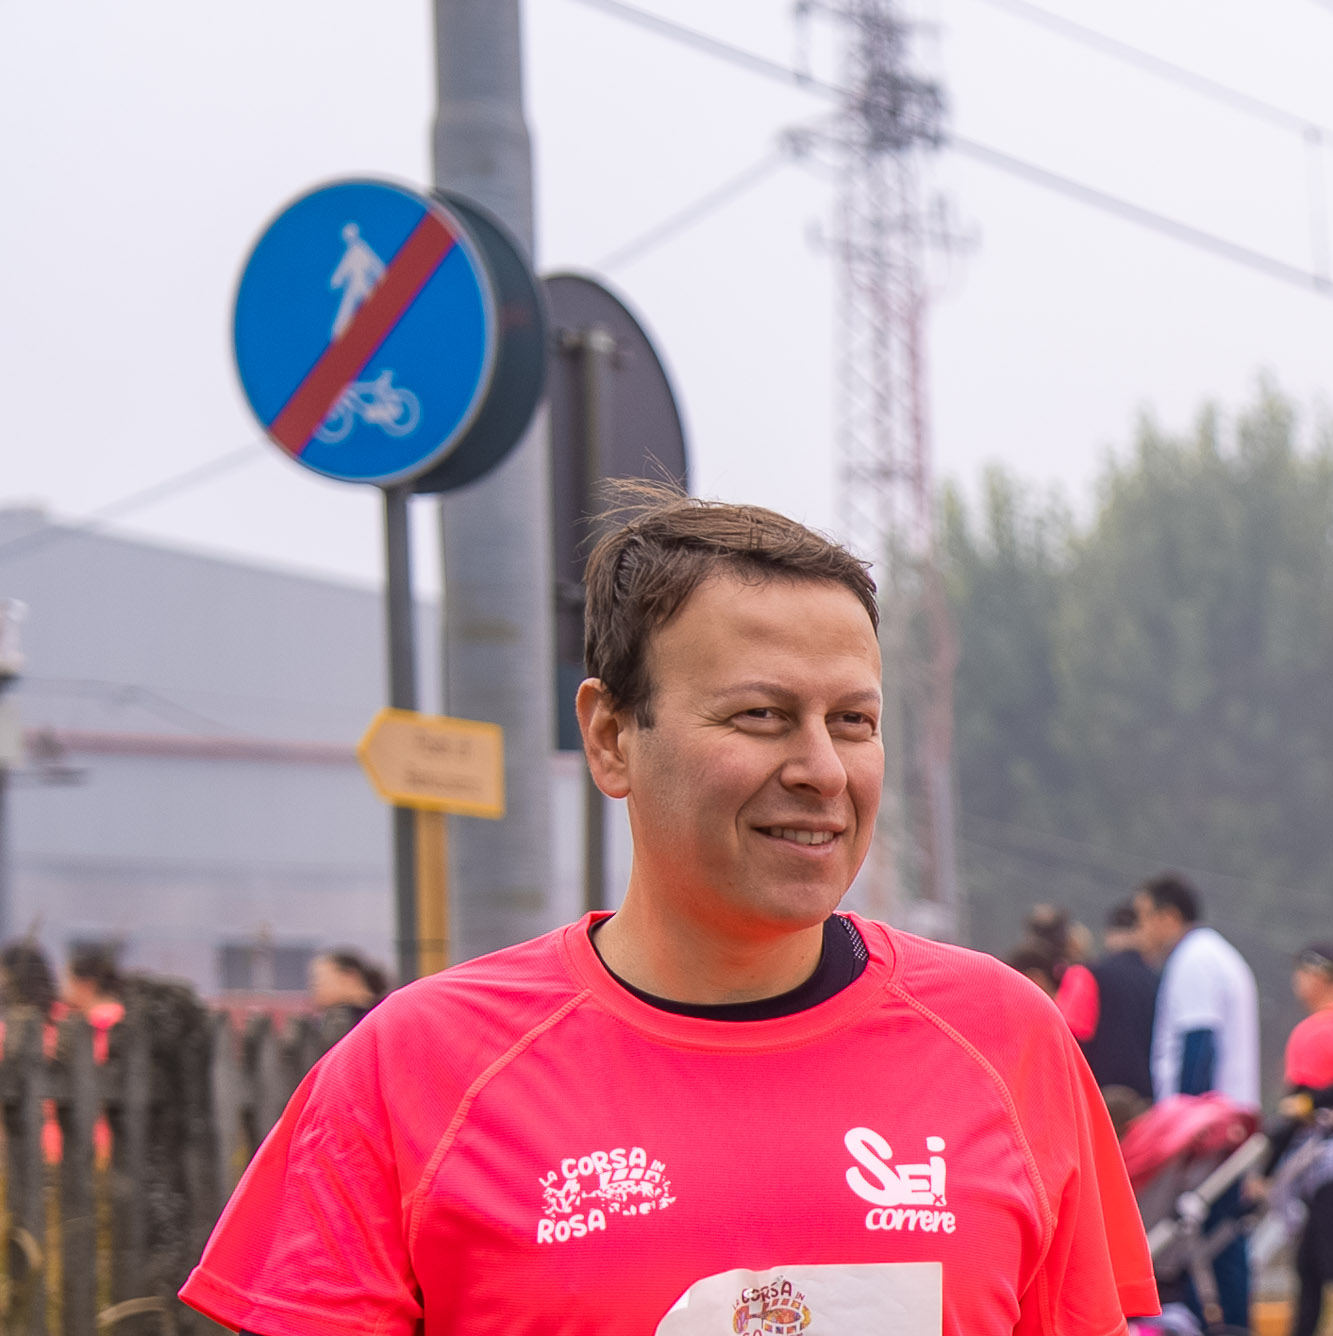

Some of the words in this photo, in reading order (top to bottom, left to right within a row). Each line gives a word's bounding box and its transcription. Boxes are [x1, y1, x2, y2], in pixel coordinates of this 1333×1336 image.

[538, 1170, 558, 1187] LA
[561, 1147, 647, 1179] CORSA
[651, 1159, 665, 1172] IN
[537, 1208, 606, 1243] ROSA
[865, 1208, 956, 1234] correre
